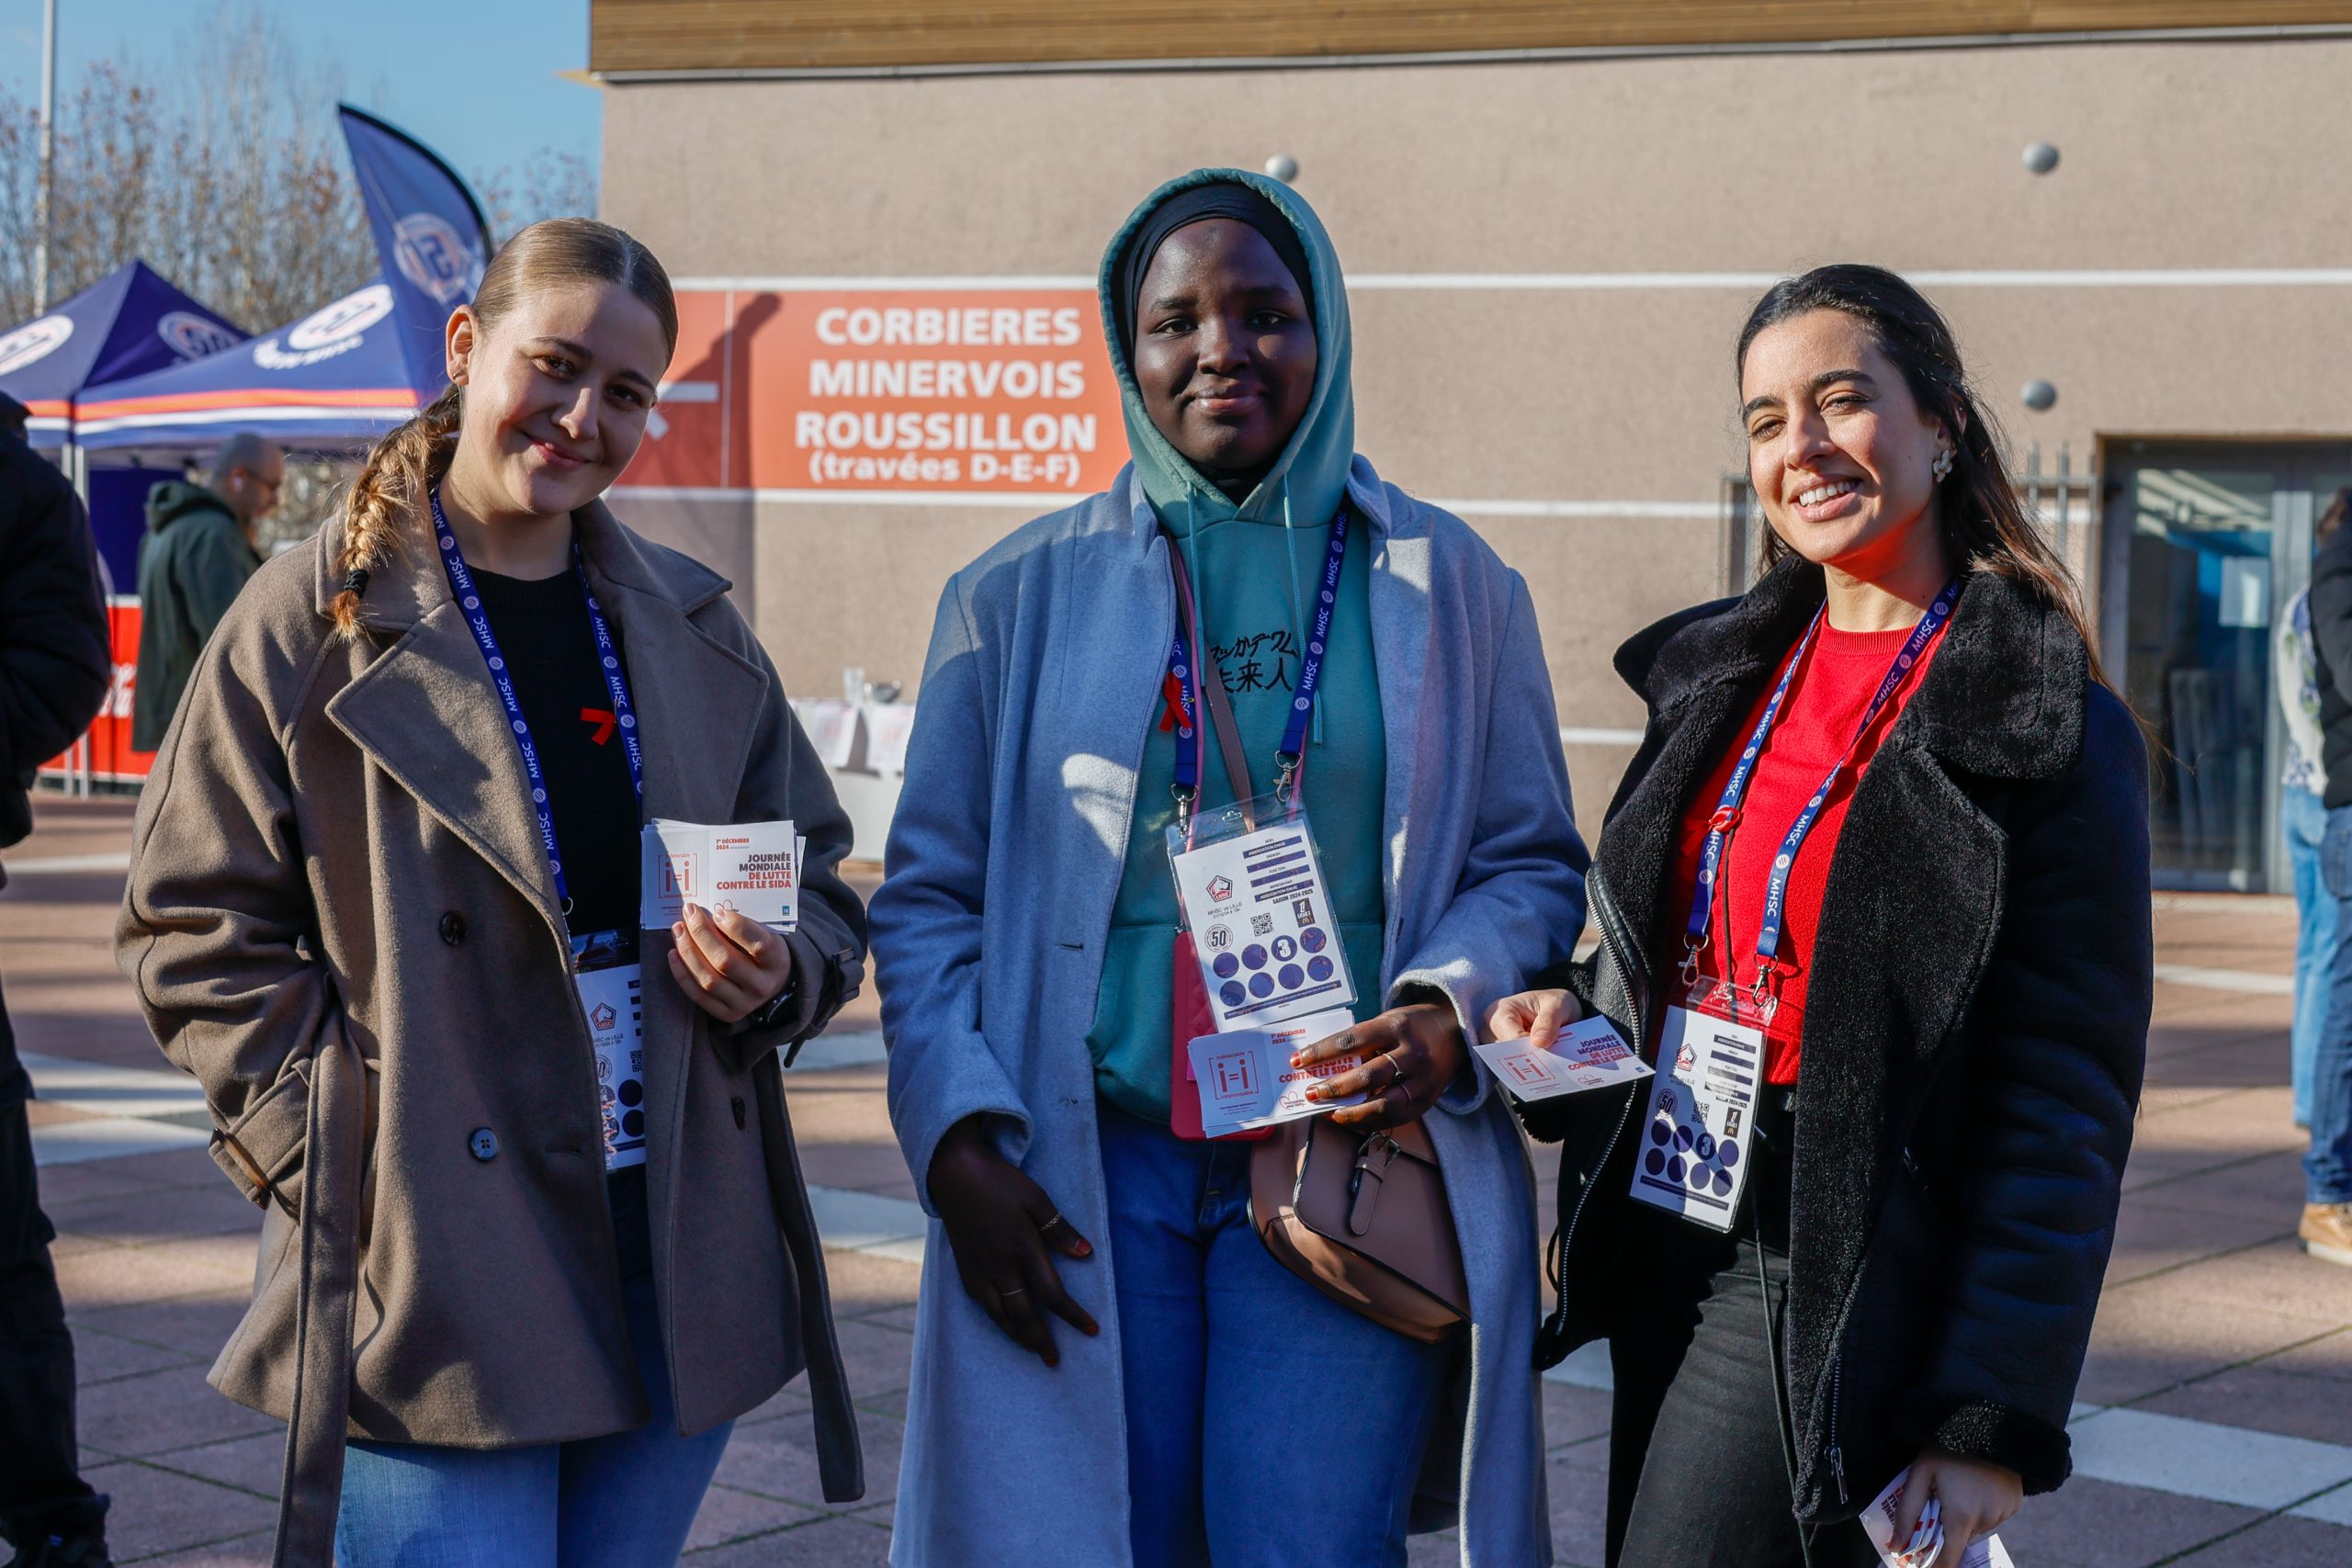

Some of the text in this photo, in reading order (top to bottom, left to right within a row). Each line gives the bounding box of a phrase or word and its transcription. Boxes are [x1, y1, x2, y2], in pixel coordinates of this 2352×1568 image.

[815, 307, 1082, 346] CORBIERES
[808, 359, 1086, 399] MINERVOIS
[795, 412, 1097, 452] ROUSSILLON
[808, 450, 1081, 488] (travées D-E-F)
[449, 556, 469, 589] MHSC
[1327, 557, 1339, 586] MHSC
[473, 616, 494, 649] MHSC
[595, 617, 610, 649] MHSC
[1316, 608, 1329, 637] MHSC
[1912, 619, 1937, 651] MHSC
[1303, 660, 1318, 691] MHSC
[1877, 672, 1899, 705] MHSC
[499, 678, 518, 712] MHSC
[610, 676, 628, 708] MHSC
[1753, 710, 1773, 740] MHSC
[522, 742, 539, 778] MHSC
[628, 737, 642, 771] MHSC
[1726, 766, 1746, 797] MHSC
[538, 812, 555, 850] MHSC
[1786, 815, 1810, 846] MHSC
[740, 863, 791, 872] MONDIALE
[748, 852, 791, 863] JOURNÉE
[717, 880, 792, 890] CONTRE LE SIDA
[749, 871, 791, 880] DE LUTTE
[1261, 889, 1285, 899] ASSOCIATION
[1272, 889, 1313, 905] SAISON 2024-2025
[1768, 878, 1781, 918] MHSC
[1212, 931, 1227, 947] 50
[1277, 939, 1291, 958] 3
[1577, 1041, 1622, 1055] MONDIALE
[1580, 1034, 1617, 1047] JOURNÉE
[1600, 1046, 1626, 1056] LUTTE
[1279, 1068, 1317, 1083] CONTRE
[1319, 1067, 1329, 1076] LE
[1331, 1064, 1353, 1074] SIDA
[1567, 1060, 1601, 1070] CONTRE
[1612, 1053, 1632, 1061] SIDA
[1660, 1095, 1673, 1113] 50
[1728, 1099, 1747, 1109] 2024-2025
[1702, 1136, 1711, 1157] 3
